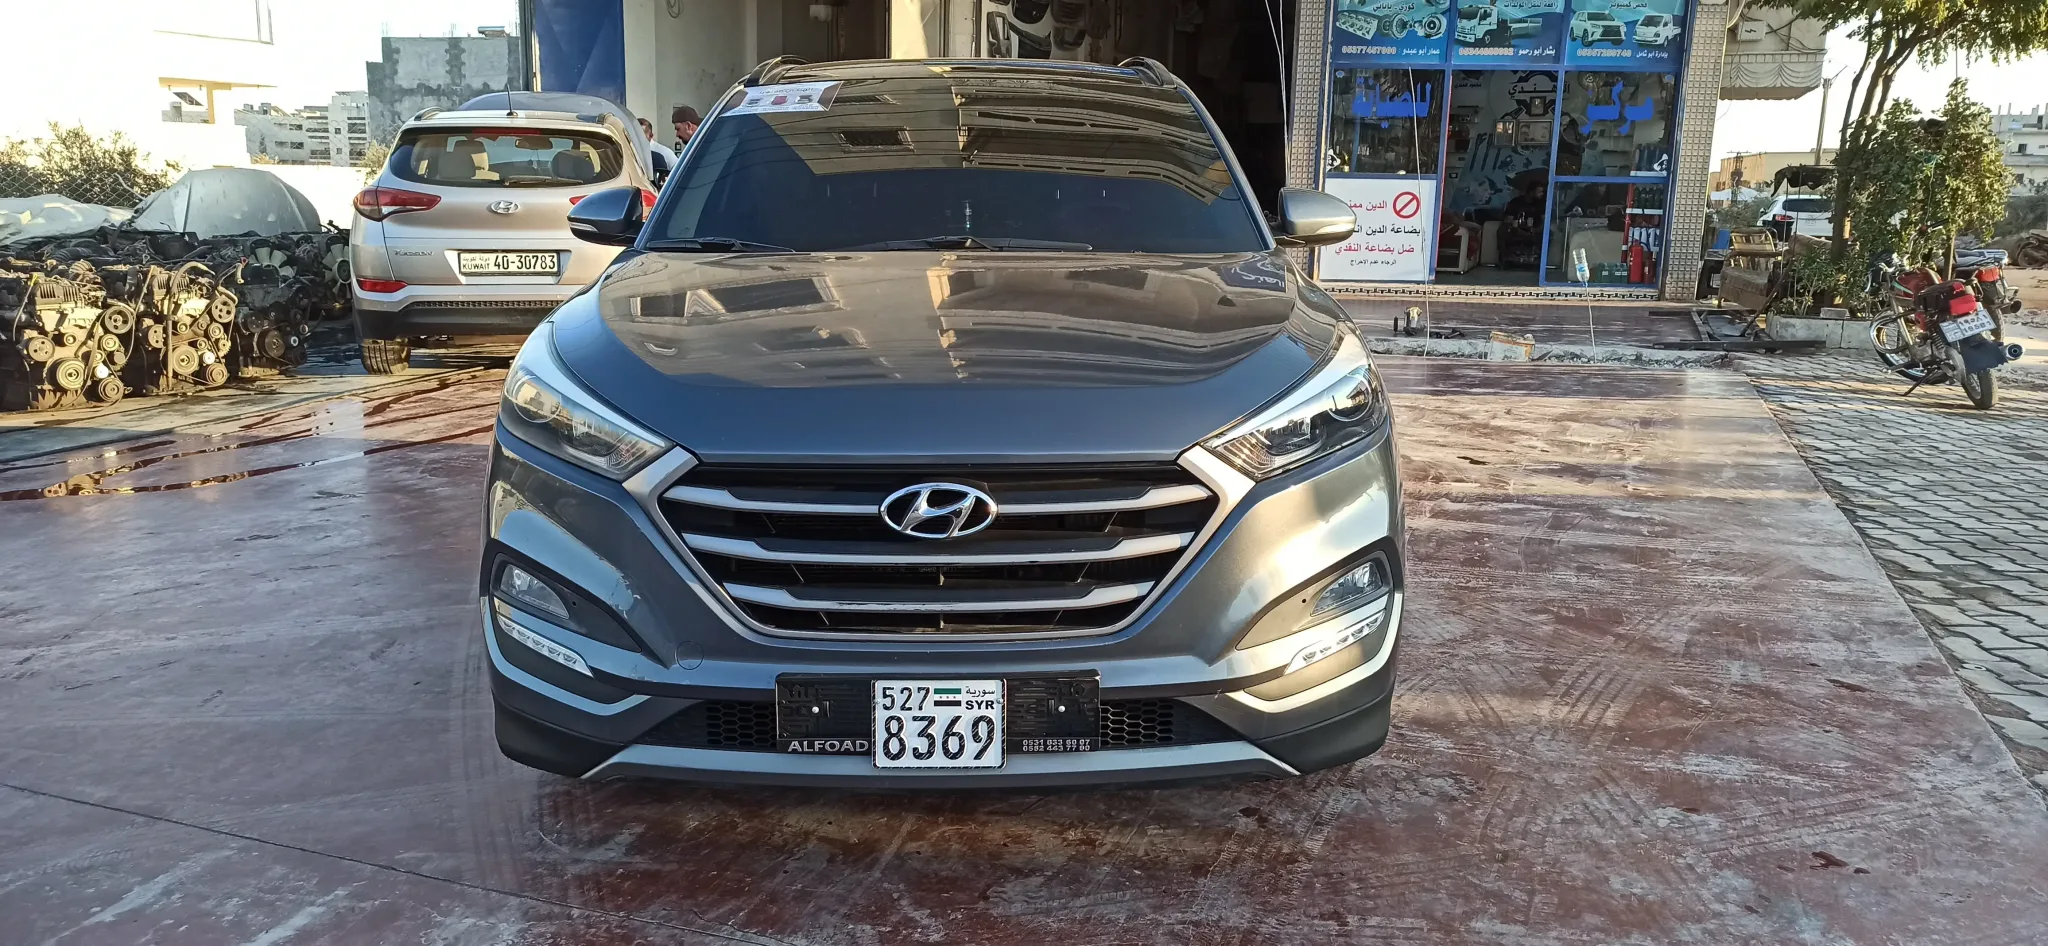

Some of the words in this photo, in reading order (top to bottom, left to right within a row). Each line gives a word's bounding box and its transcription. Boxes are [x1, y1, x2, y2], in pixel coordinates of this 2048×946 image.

[1399, 3, 1415, 11] كوري
[1352, 76, 1431, 129] للصيانة
[1578, 80, 1655, 135] مركز
[1366, 200, 1387, 211] الدين
[1366, 224, 1387, 236] الدين
[1390, 223, 1421, 237] بضاعة
[1335, 242, 1362, 256] النقدي
[1365, 242, 1395, 255] بضاعة
[494, 254, 556, 270] 40-30783
[965, 685, 996, 698] سورية
[882, 686, 931, 711] 527
[965, 700, 996, 710] SYR
[882, 715, 996, 761] 8369
[787, 740, 869, 752] ALFOAD
